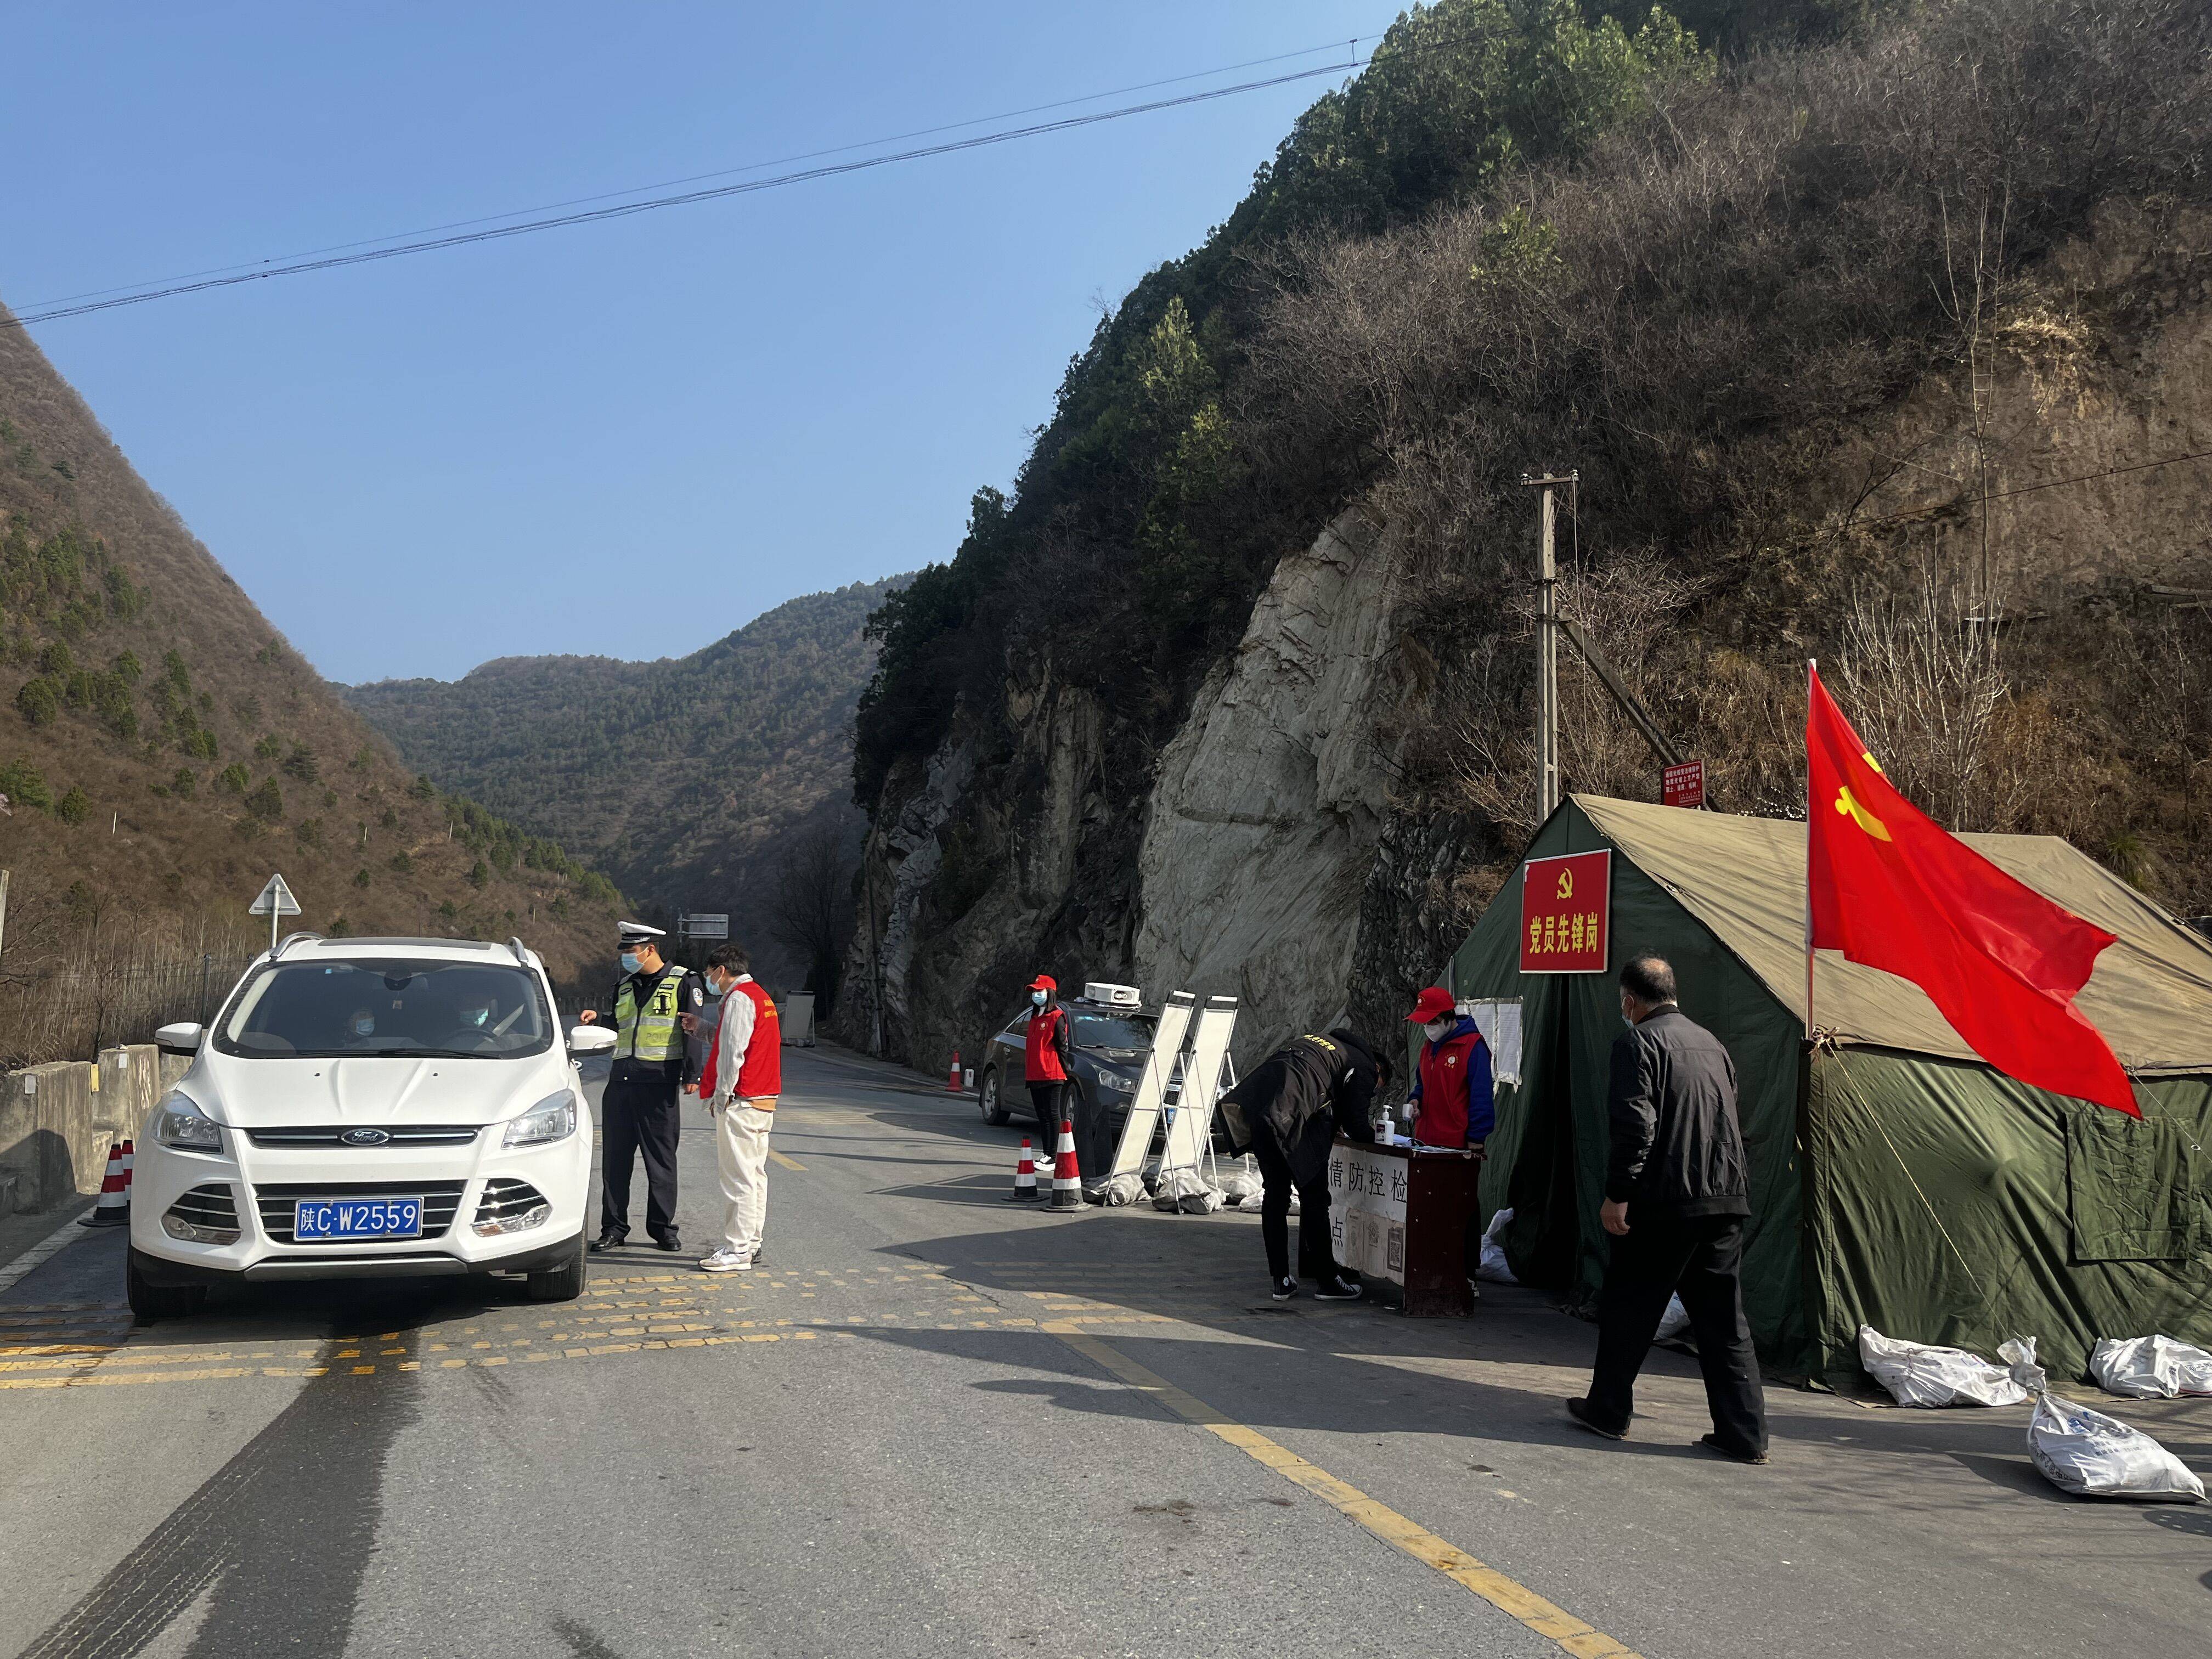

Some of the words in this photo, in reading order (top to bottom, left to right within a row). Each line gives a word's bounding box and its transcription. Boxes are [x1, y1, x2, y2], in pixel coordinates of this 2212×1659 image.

[1529, 911, 1598, 954] 党员先锋岗
[352, 1131, 379, 1142] Ford
